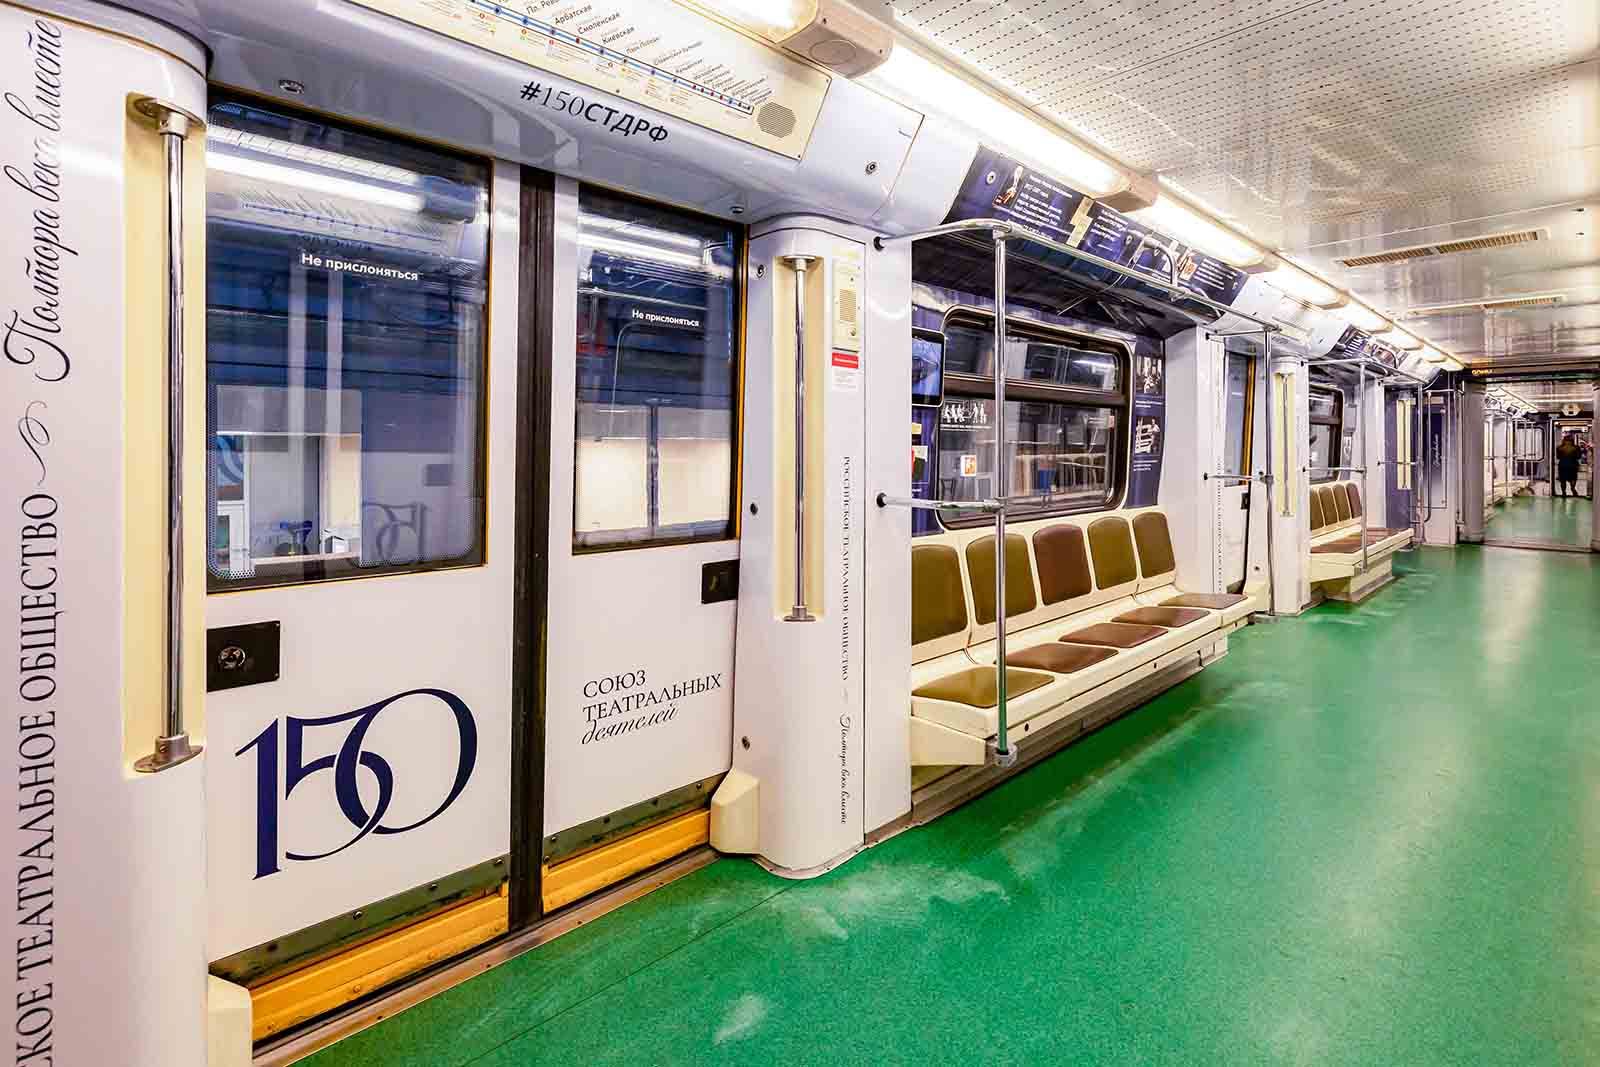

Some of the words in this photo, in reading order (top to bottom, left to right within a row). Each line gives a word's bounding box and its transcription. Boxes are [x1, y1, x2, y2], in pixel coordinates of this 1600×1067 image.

[554, 4, 592, 25] Арбатская
[576, 12, 621, 35] Смоленская
[602, 26, 636, 44] Киевская
[3, 19, 62, 132] вместе
[520, 81, 669, 142] #150СТДРФ
[301, 252, 322, 267] Не
[325, 258, 419, 281] прислоняться
[3, 207, 79, 382] Полтора
[632, 308, 644, 319] Не
[645, 312, 700, 327] прислоняться
[19, 493, 68, 702] ОБЩЕСТВО
[582, 673, 721, 722] ТЕАТРАЛЬНЫХ
[583, 669, 646, 698] СОЮЗ
[581, 703, 677, 745] деятелей
[235, 688, 478, 880] 150
[17, 709, 56, 981] ТЕАТРАЛЬНОЕ
[16, 982, 54, 1067] КОЕ
